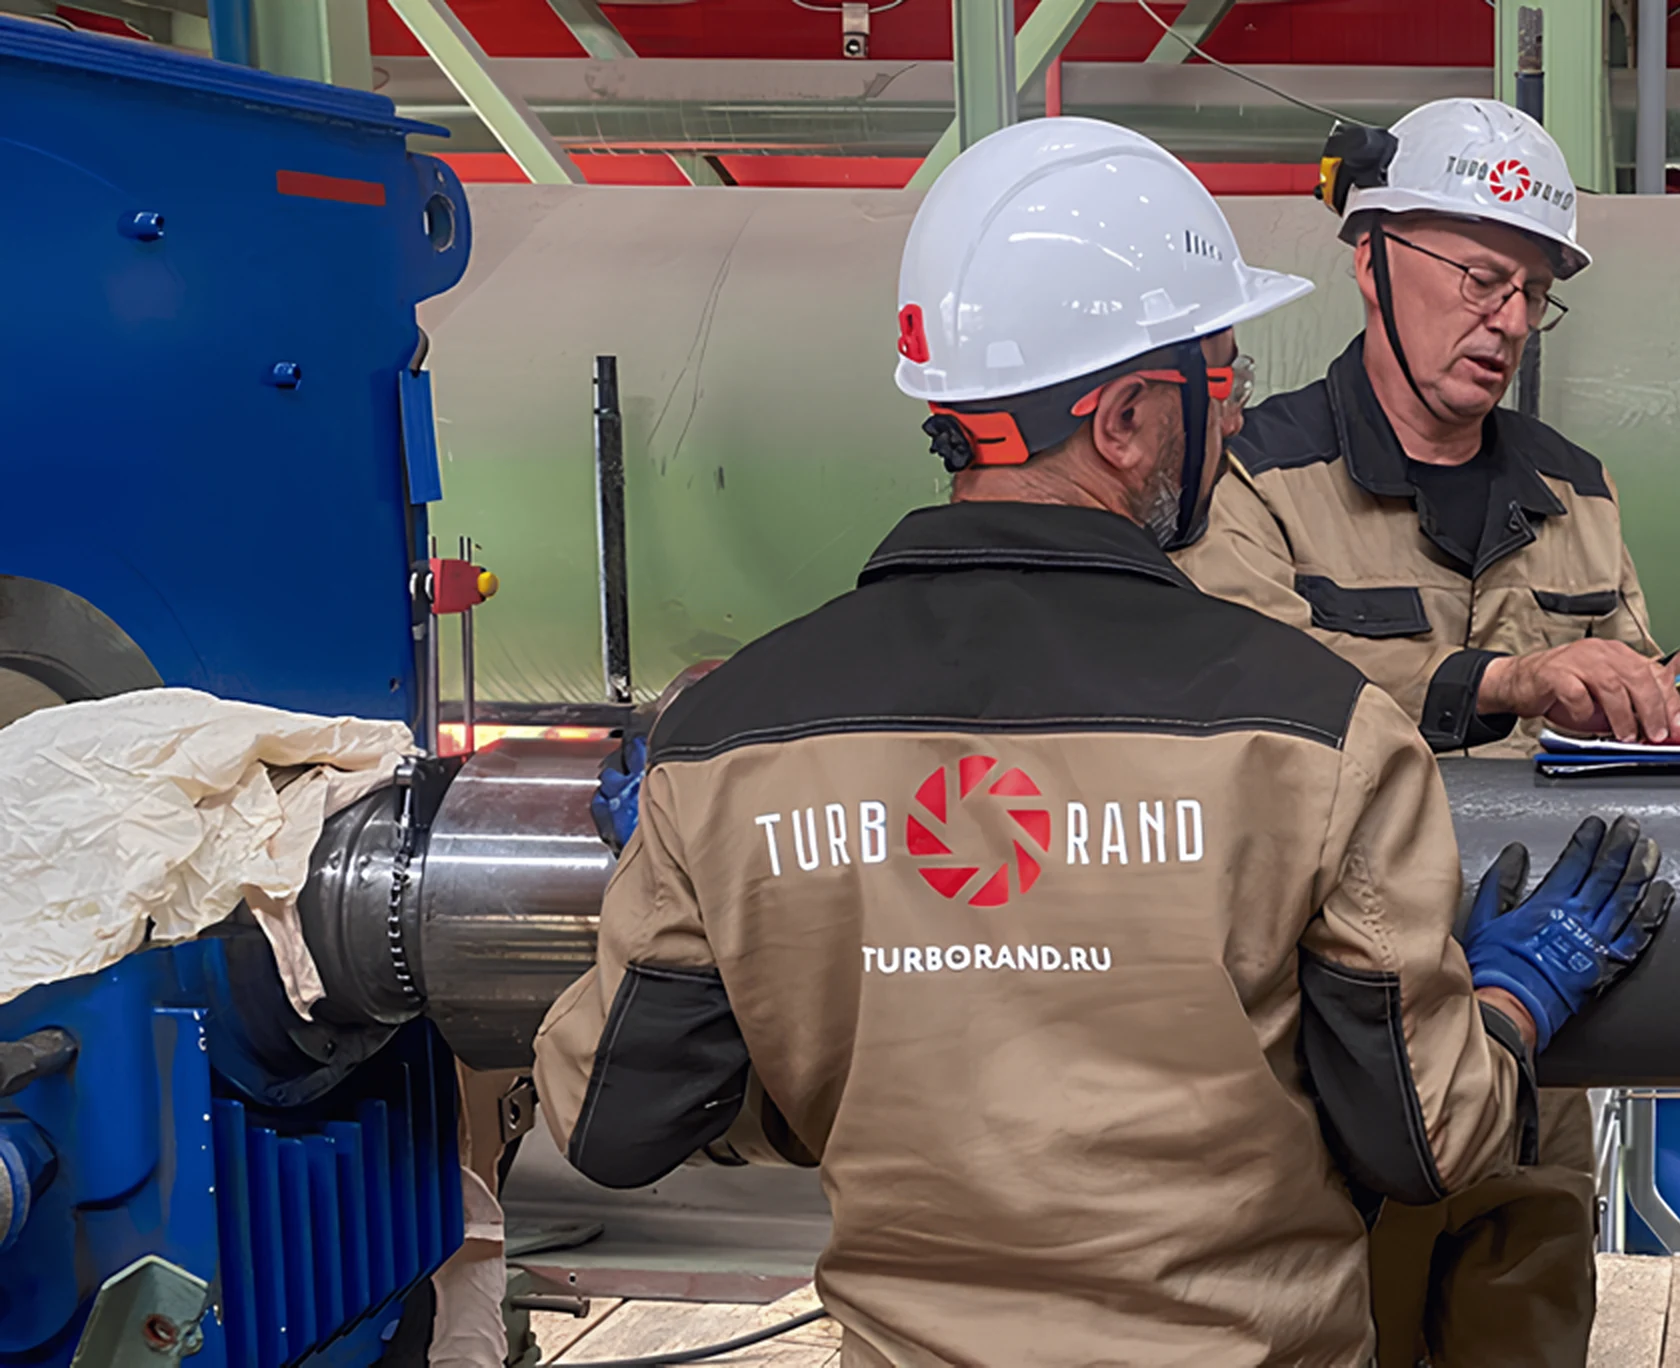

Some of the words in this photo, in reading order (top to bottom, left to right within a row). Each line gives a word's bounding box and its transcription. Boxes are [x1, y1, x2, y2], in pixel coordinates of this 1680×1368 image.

[755, 801, 887, 876] TURB
[1067, 799, 1205, 865] RAND
[862, 944, 1111, 974] TURBORAND.RU
